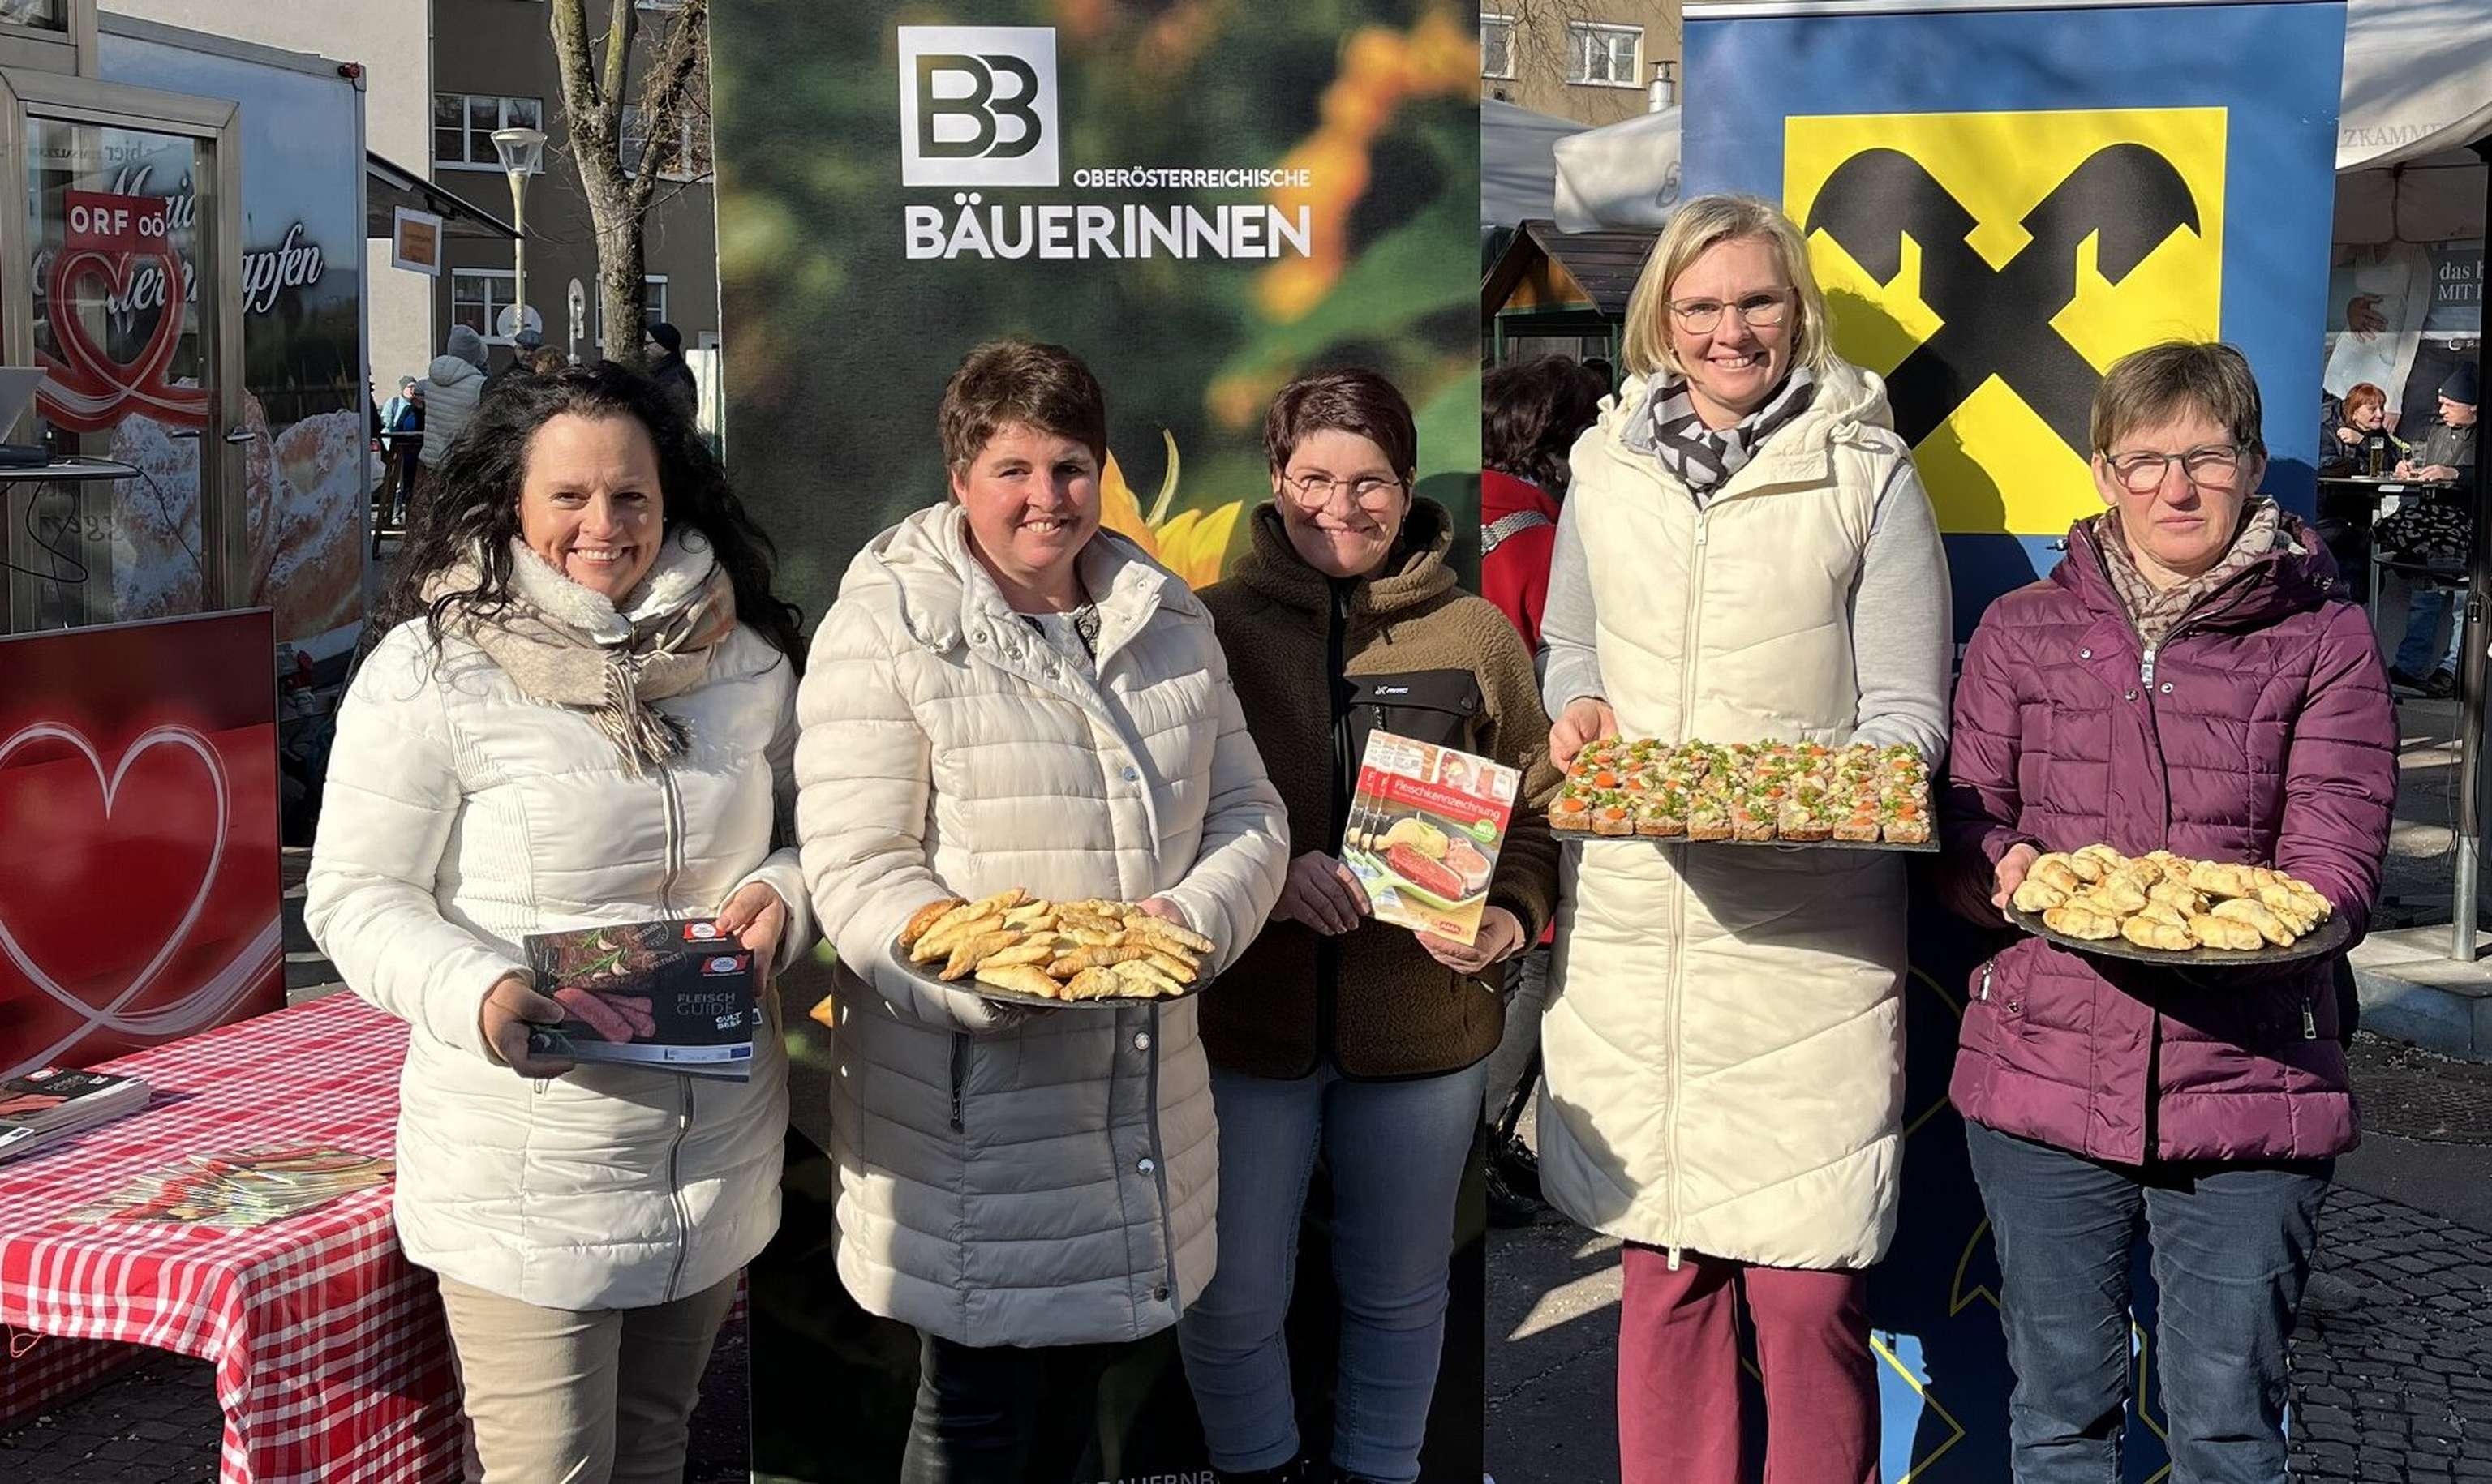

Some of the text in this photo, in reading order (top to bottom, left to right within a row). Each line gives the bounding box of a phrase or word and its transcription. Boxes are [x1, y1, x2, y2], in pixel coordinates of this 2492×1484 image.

[1073, 166, 1311, 187] OBERÖSTERREICHISCHE
[71, 205, 129, 236] ORF
[905, 192, 1311, 259] BÄUERINNEN
[2439, 262, 2470, 281] das
[2439, 284, 2473, 301] MIT
[1394, 779, 1501, 821] Fleischkennzeichnung
[677, 992, 736, 1004] FLEISCH
